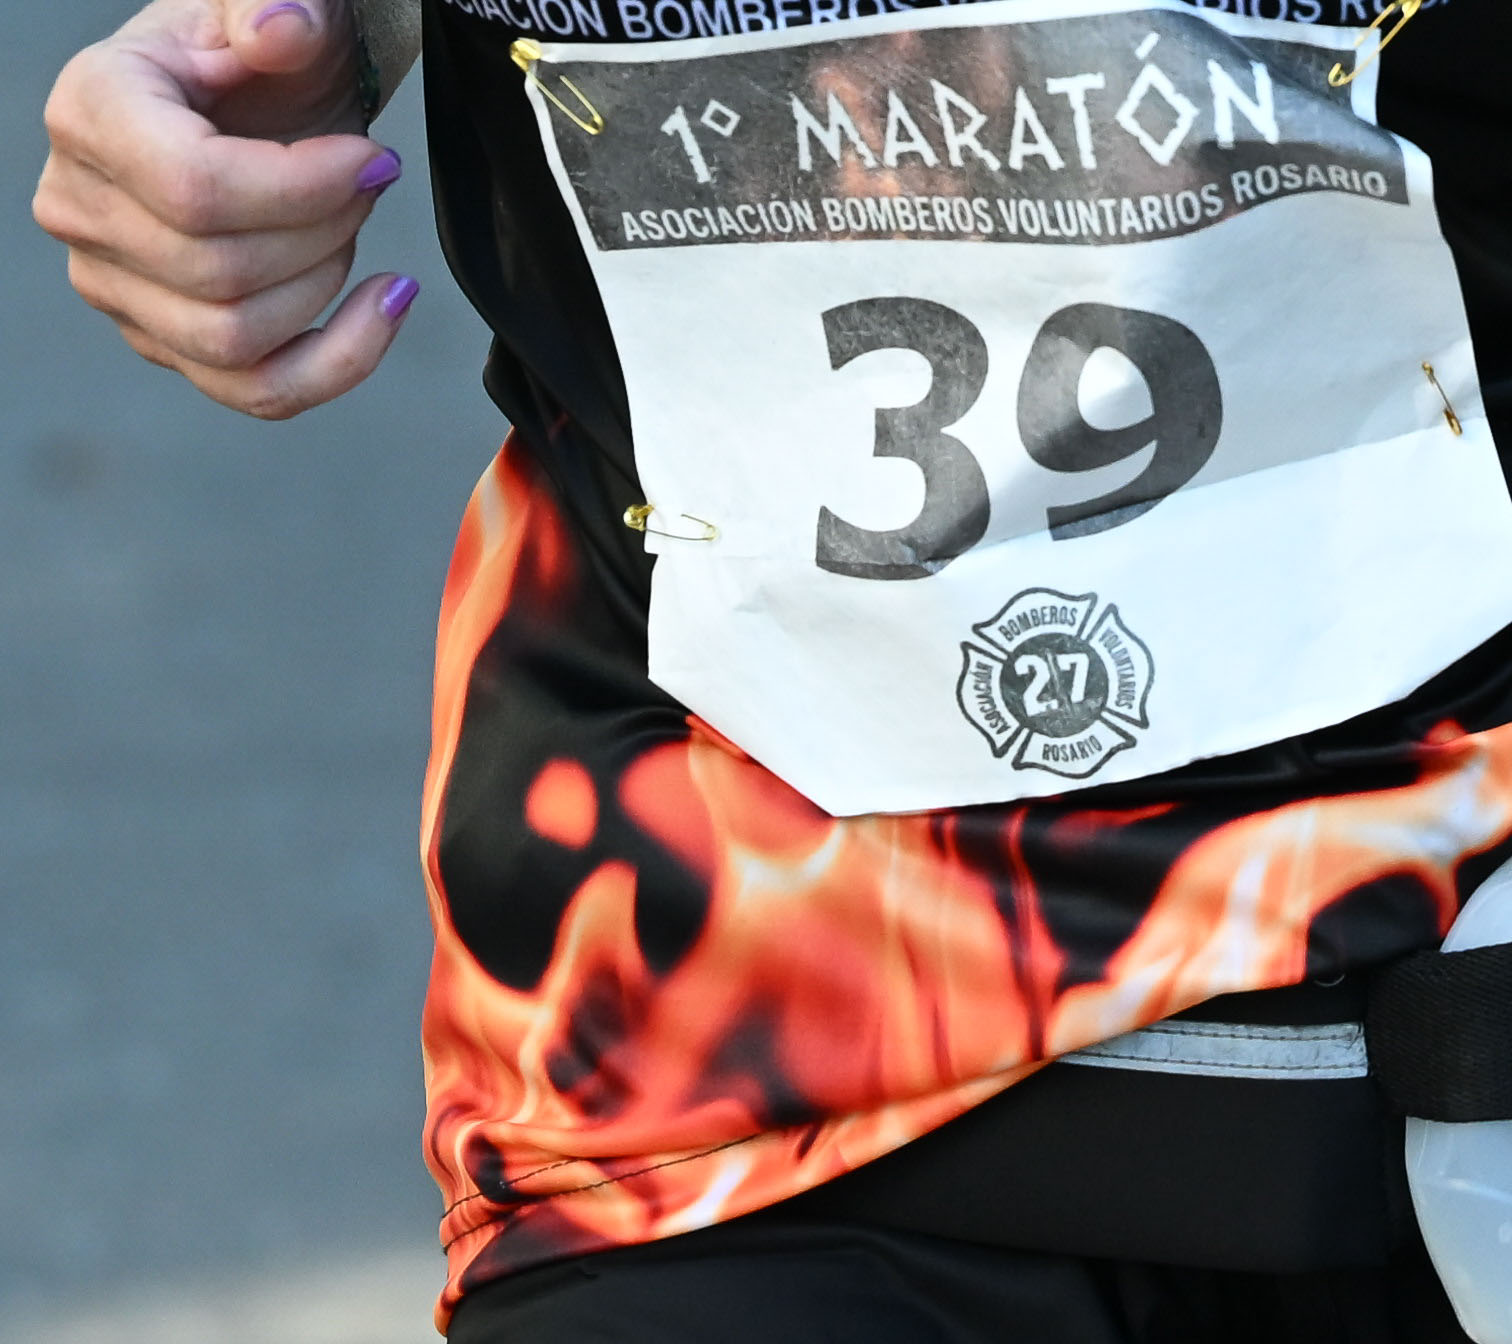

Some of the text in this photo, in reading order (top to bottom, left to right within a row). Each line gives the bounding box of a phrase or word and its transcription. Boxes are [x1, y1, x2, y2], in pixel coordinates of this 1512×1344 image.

[791, 31, 1281, 175] MARATÓN
[619, 160, 1388, 244] ASOCIACIÓN BOMBEROS VOLUNTARIOS ROSARIO
[815, 297, 1223, 582] 39
[998, 605, 1078, 642] BOMBEROS
[1014, 653, 1090, 717] 27
[1098, 627, 1136, 710] VOLUNTARIOS
[1041, 735, 1103, 762] ROSARIO
